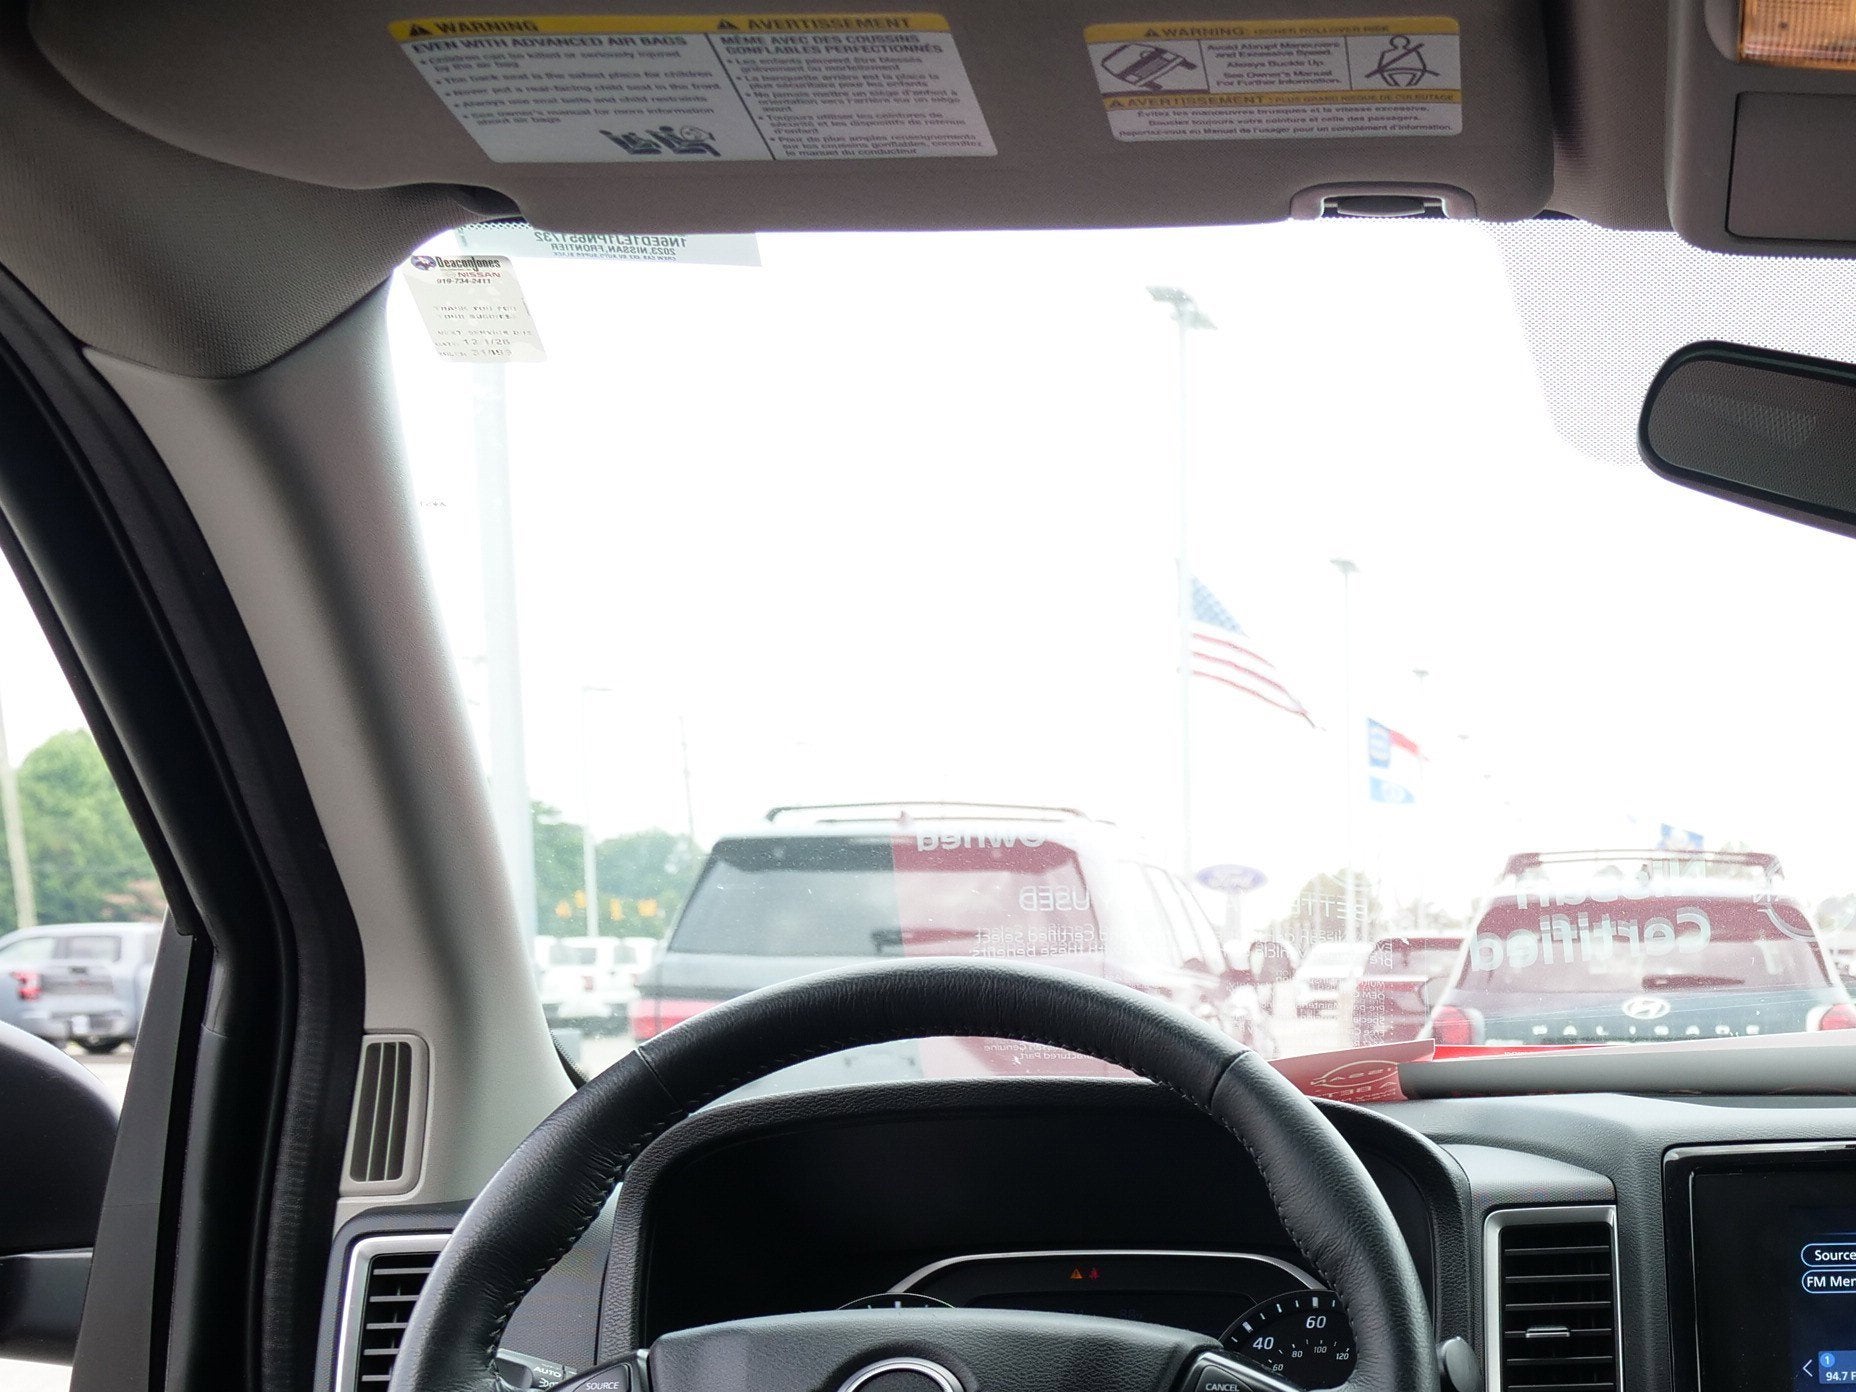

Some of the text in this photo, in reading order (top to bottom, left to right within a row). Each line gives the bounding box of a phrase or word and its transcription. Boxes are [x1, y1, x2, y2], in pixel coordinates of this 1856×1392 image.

[434, 20, 539, 33] WARNING
[749, 18, 911, 31] AVERTISSEMENT
[771, 34, 808, 43] AVEC
[813, 34, 841, 43] DES
[846, 33, 920, 43] COUSSINS
[411, 37, 687, 53] EVEN WITH ADVANCED AIR BAGS
[726, 45, 821, 54] GONFLABLES
[1815, 1249, 1856, 1261] Source
[1807, 1276, 1828, 1288] FM
[1306, 1314, 1327, 1329] 60
[1253, 1336, 1274, 1351] 40
[1292, 1349, 1303, 1358] 80
[1335, 1352, 1349, 1360] 120
[1272, 1363, 1284, 1371] 60
[1826, 1370, 1849, 1382] 94.7
[585, 1380, 619, 1391] SOURCE
[1205, 1382, 1239, 1392] CANCEL
